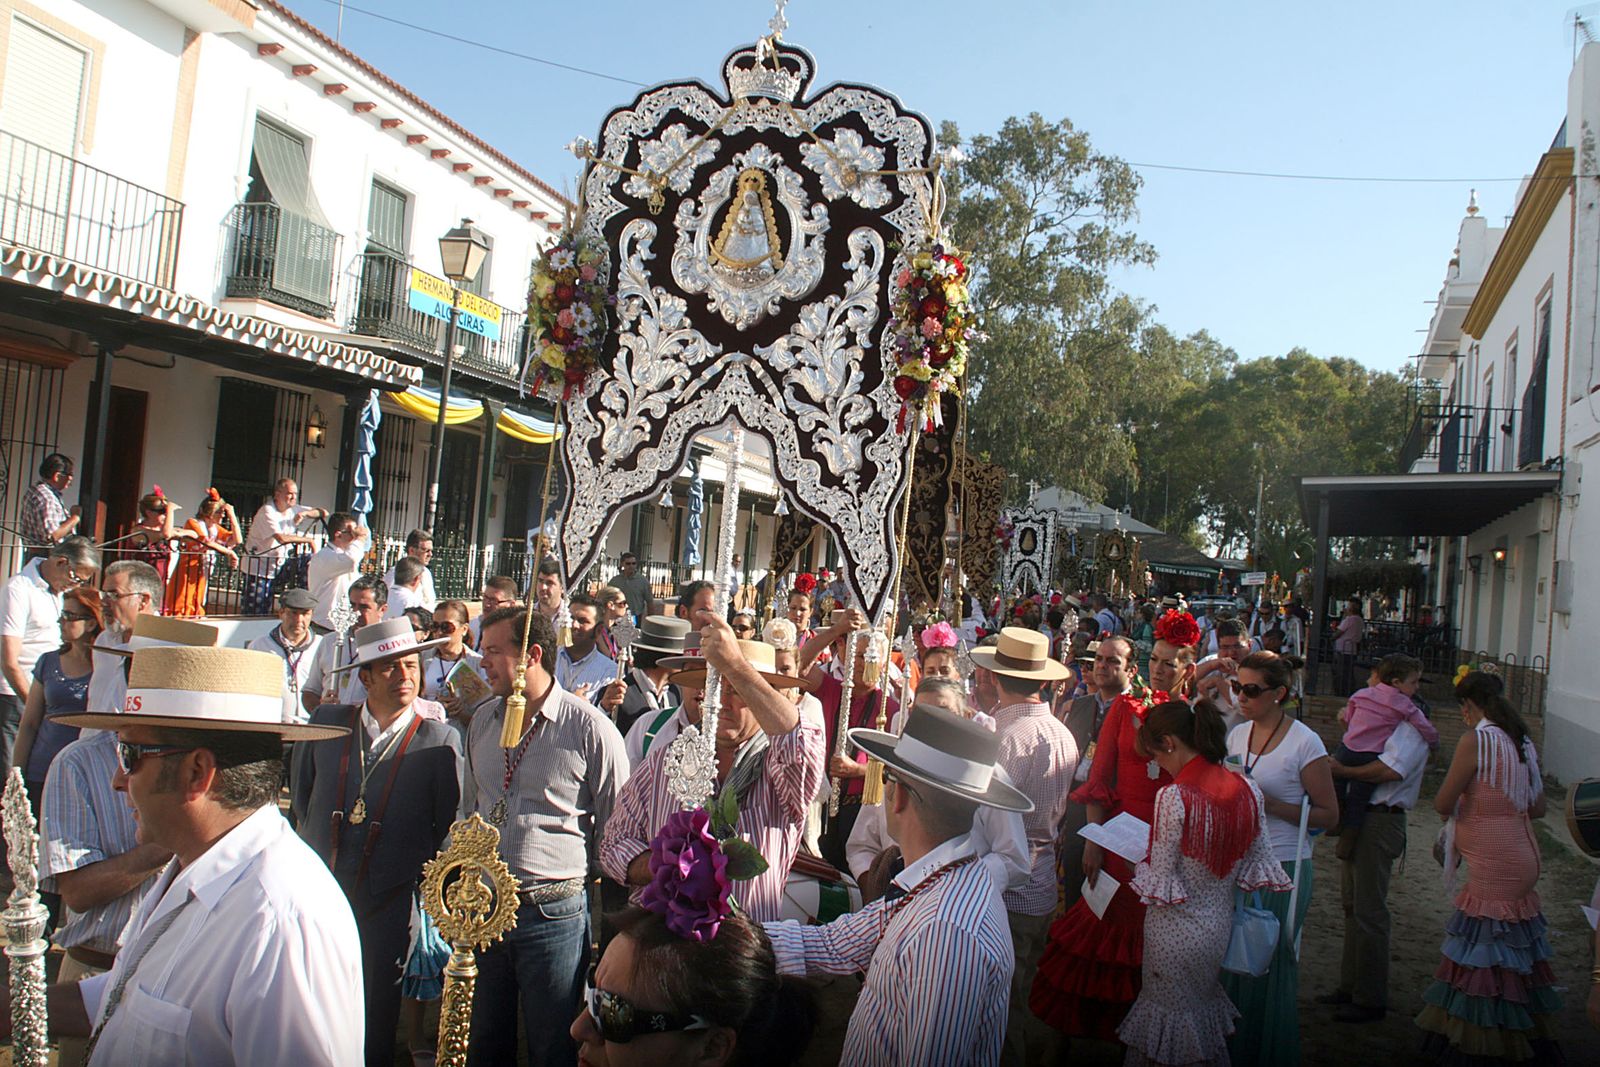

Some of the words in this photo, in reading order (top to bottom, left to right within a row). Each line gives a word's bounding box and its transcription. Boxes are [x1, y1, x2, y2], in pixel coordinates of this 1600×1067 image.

[418, 273, 463, 304] HERMANDD
[465, 294, 477, 311] DEL
[434, 302, 485, 333] ALGCIRAS
[1155, 566, 1177, 575] TIENDA
[1179, 570, 1211, 578] FLAMENCA
